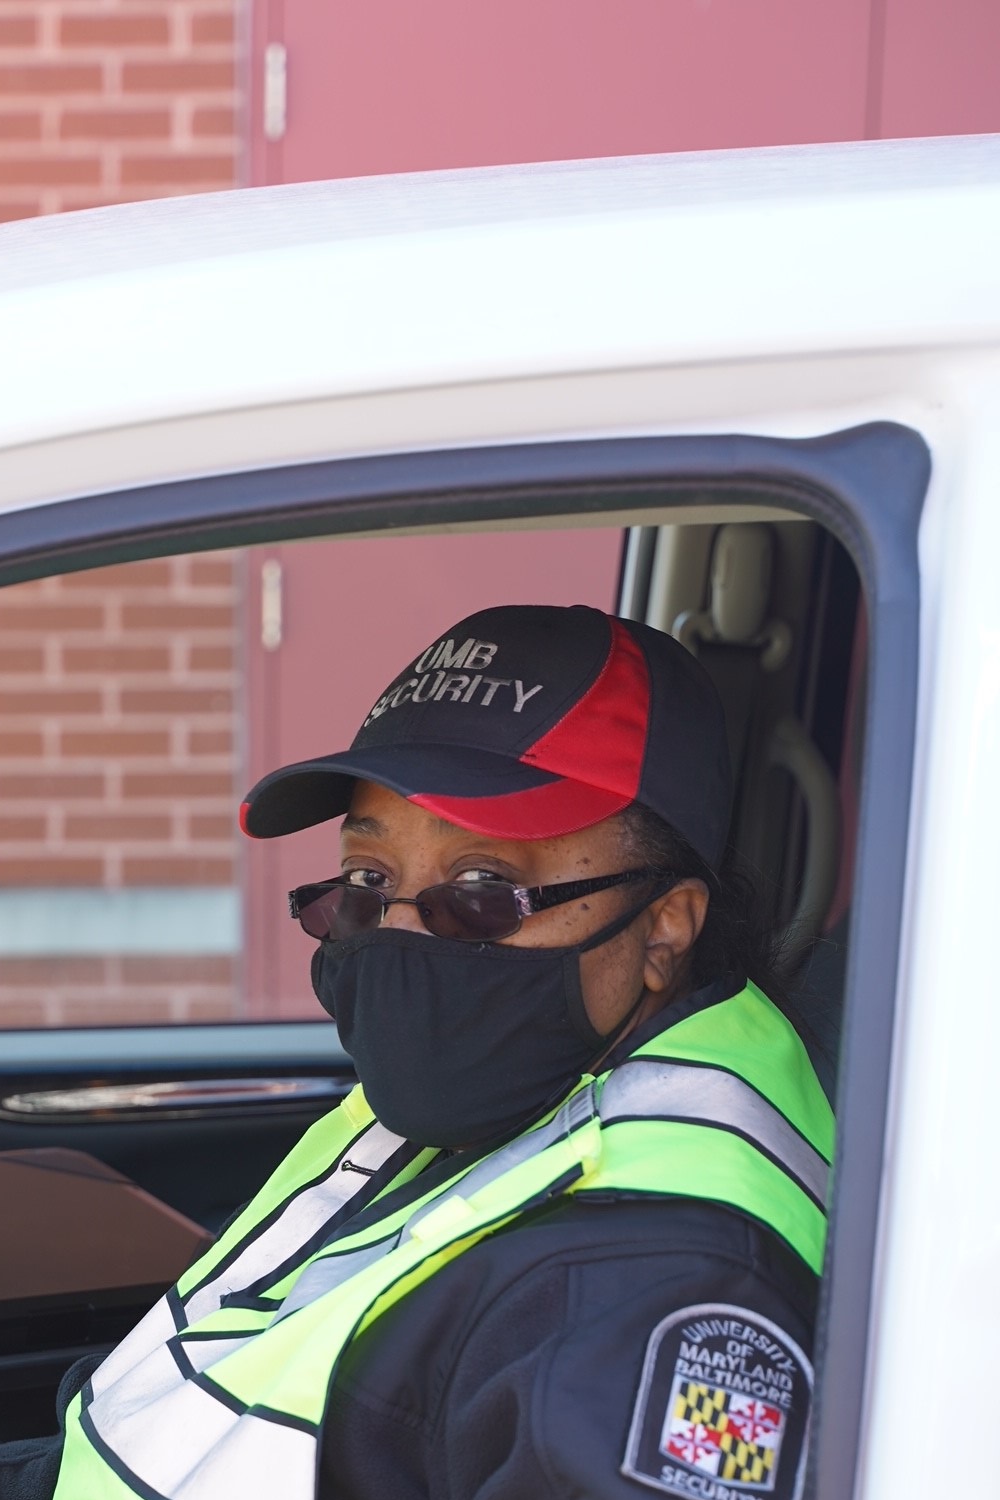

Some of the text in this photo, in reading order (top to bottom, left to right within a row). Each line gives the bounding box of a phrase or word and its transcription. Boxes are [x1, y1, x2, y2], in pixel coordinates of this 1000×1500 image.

[414, 637, 499, 674] UMB
[679, 1341, 794, 1392] MARYLAND
[681, 1319, 797, 1375] UNIVERSITY
[726, 1340, 753, 1357] OF
[675, 1358, 793, 1407] BALTIMORE
